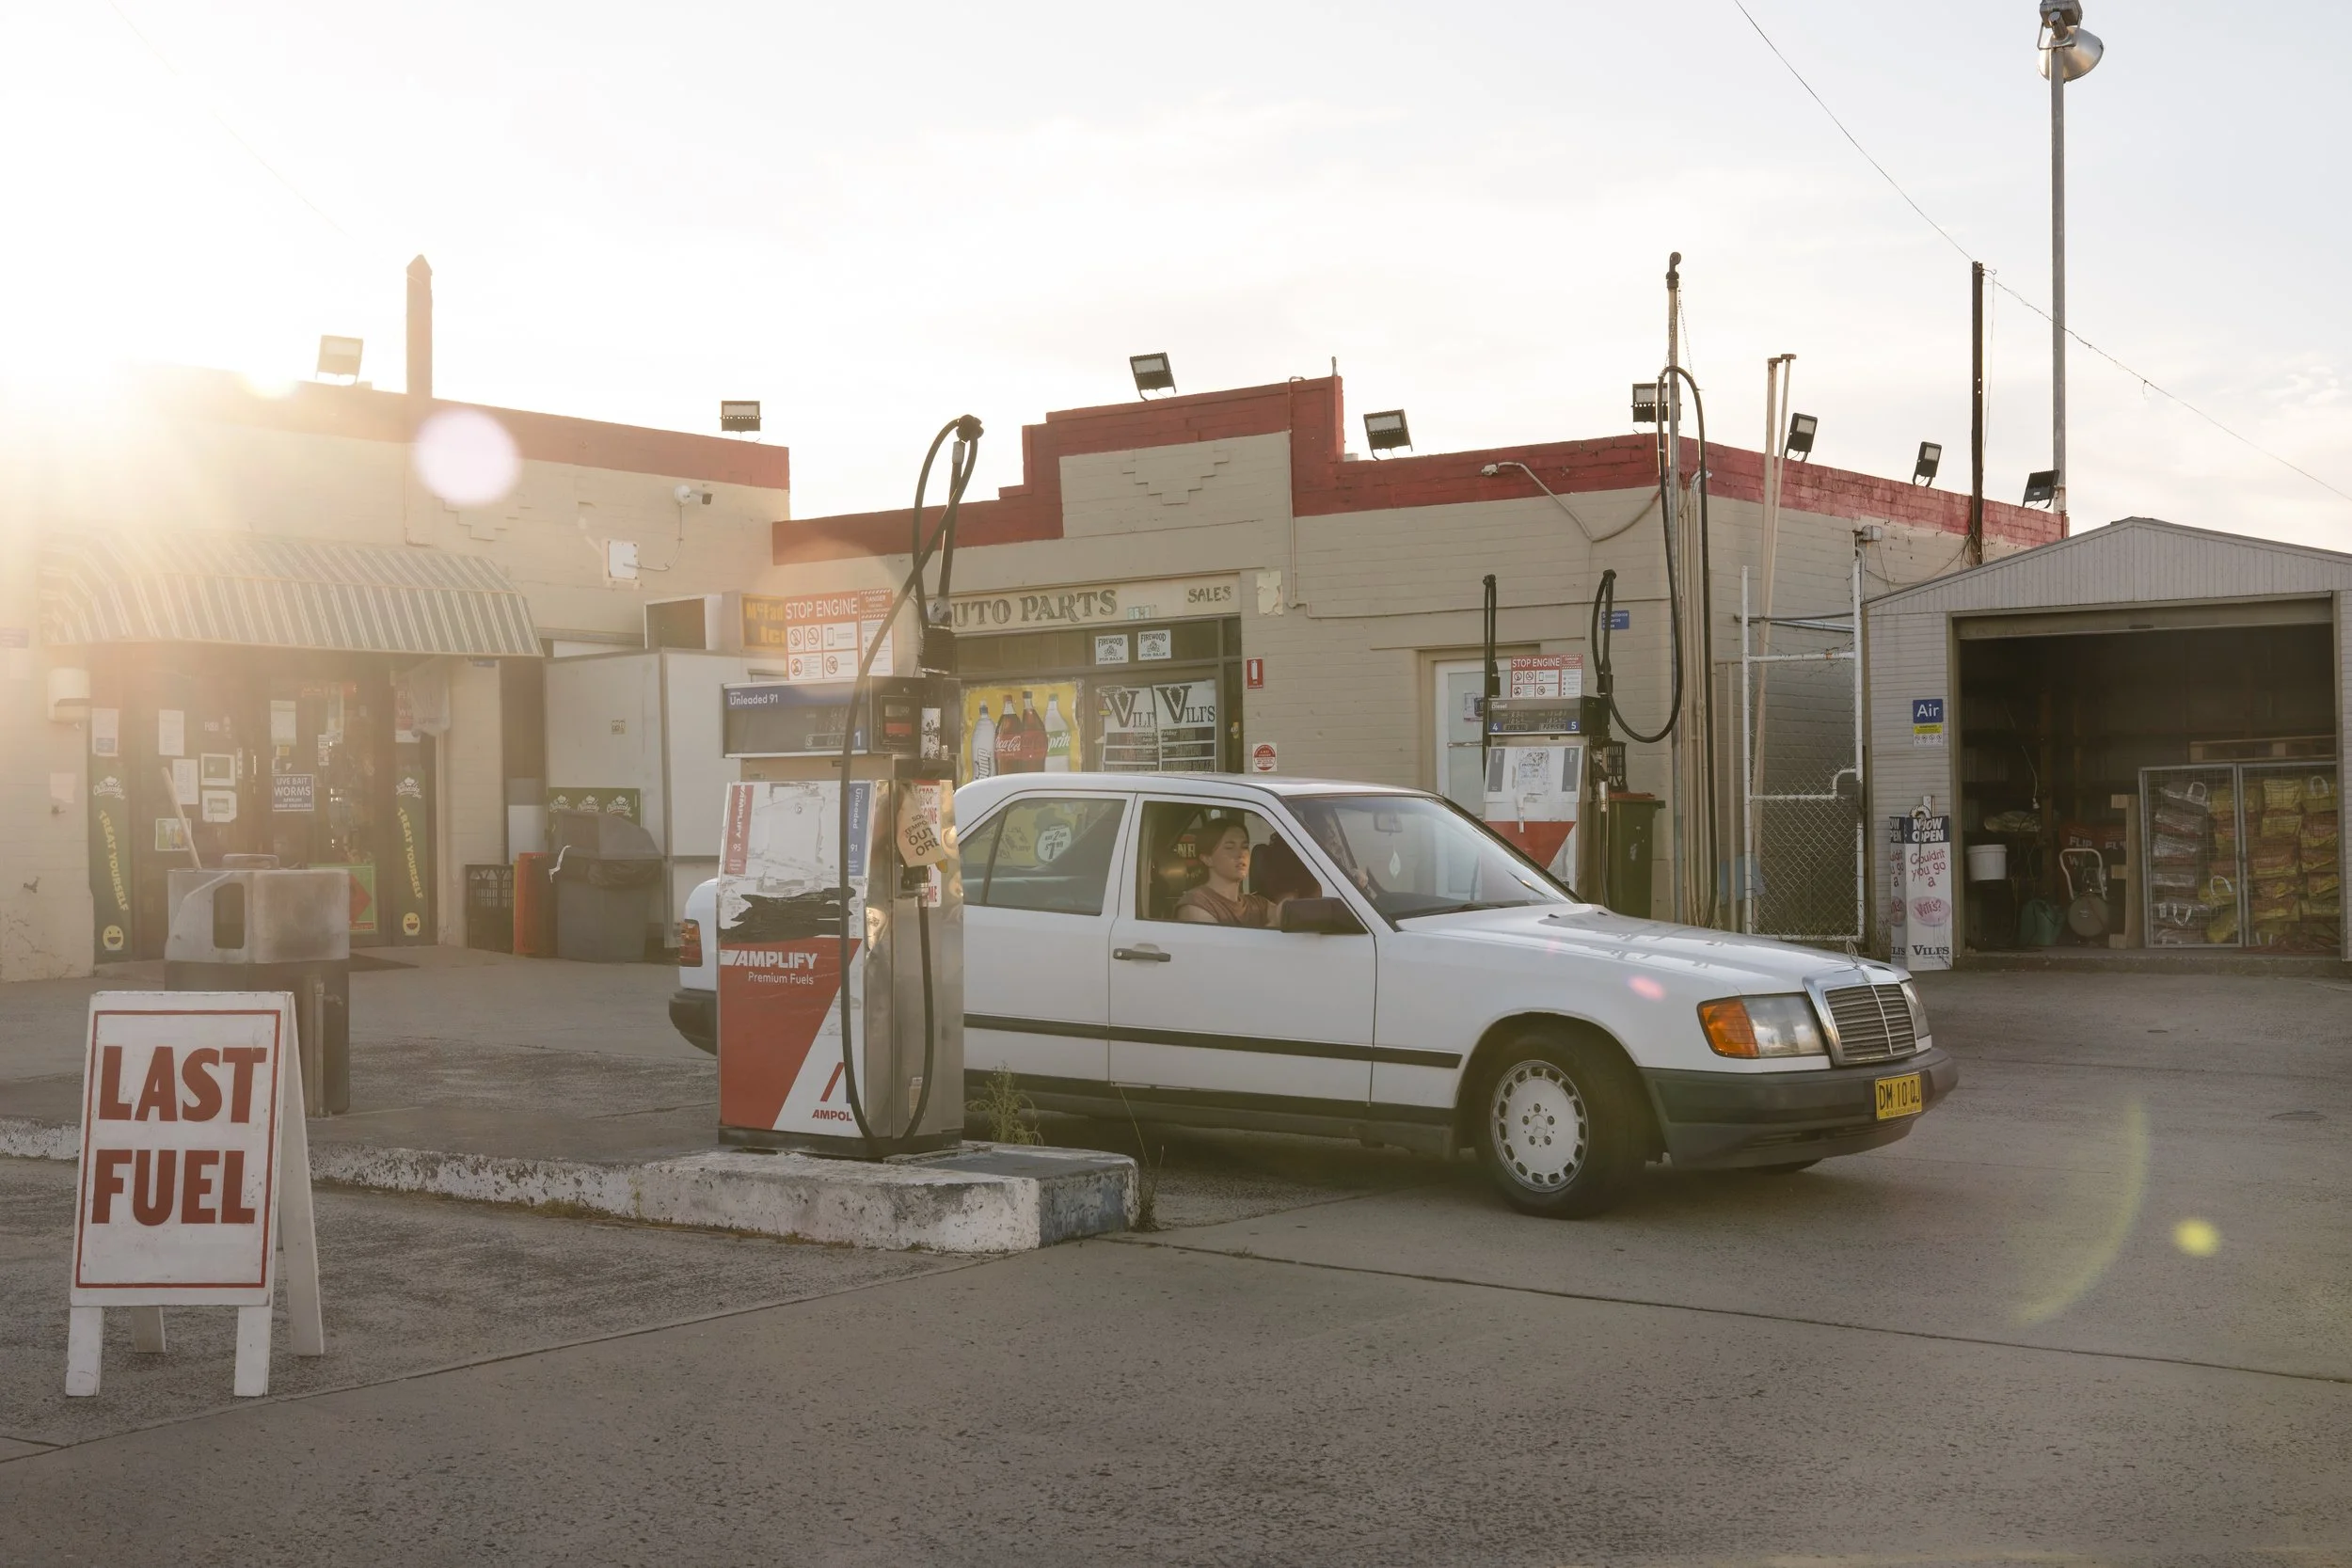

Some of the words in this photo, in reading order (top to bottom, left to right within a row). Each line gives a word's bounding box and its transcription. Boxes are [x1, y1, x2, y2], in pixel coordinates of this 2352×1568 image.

[1187, 586, 1232, 603] SALES
[746, 601, 784, 621] McFad
[786, 601, 814, 620] STOP
[816, 597, 858, 617] ENGINE
[951, 599, 1011, 626] UTO
[1019, 589, 1118, 623] PARTS
[1098, 638, 1124, 647] FIREWOOD
[1140, 633, 1167, 643] FIREWOOD
[1512, 658, 1532, 668] STOP
[1533, 657, 1560, 667] ENGINE
[730, 694, 768, 705] Unleaded
[769, 693, 779, 704] 91
[1916, 704, 1939, 717] Air
[1492, 722, 1499, 731] 4
[1570, 721, 1577, 730] 5
[854, 731, 862, 747] 1
[277, 777, 291, 785] LIVE
[292, 777, 308, 785] BAIT
[274, 786, 311, 797] WORMS
[852, 788, 863, 830] Unleaded
[1913, 817, 1943, 831] NOW
[909, 828, 933, 846] OUT
[1053, 831, 1060, 841] 2
[1889, 830, 1901, 842] PEN
[1912, 830, 1944, 842] OPEN
[397, 807, 413, 843] TREAT
[405, 845, 424, 899] YOURSELF
[850, 843, 858, 852] 91
[99, 810, 117, 849] TREAT
[108, 852, 129, 911] YOURSELF
[1912, 866, 1931, 881] you
[1933, 862, 1946, 875] go
[1928, 877, 1936, 887] a
[735, 951, 818, 970] AMPLIFY
[748, 972, 787, 984] Premium
[790, 974, 814, 986] Fuels
[98, 1045, 268, 1123] LAST
[812, 1109, 852, 1122] AMPOL
[91, 1149, 256, 1227] FUEL
